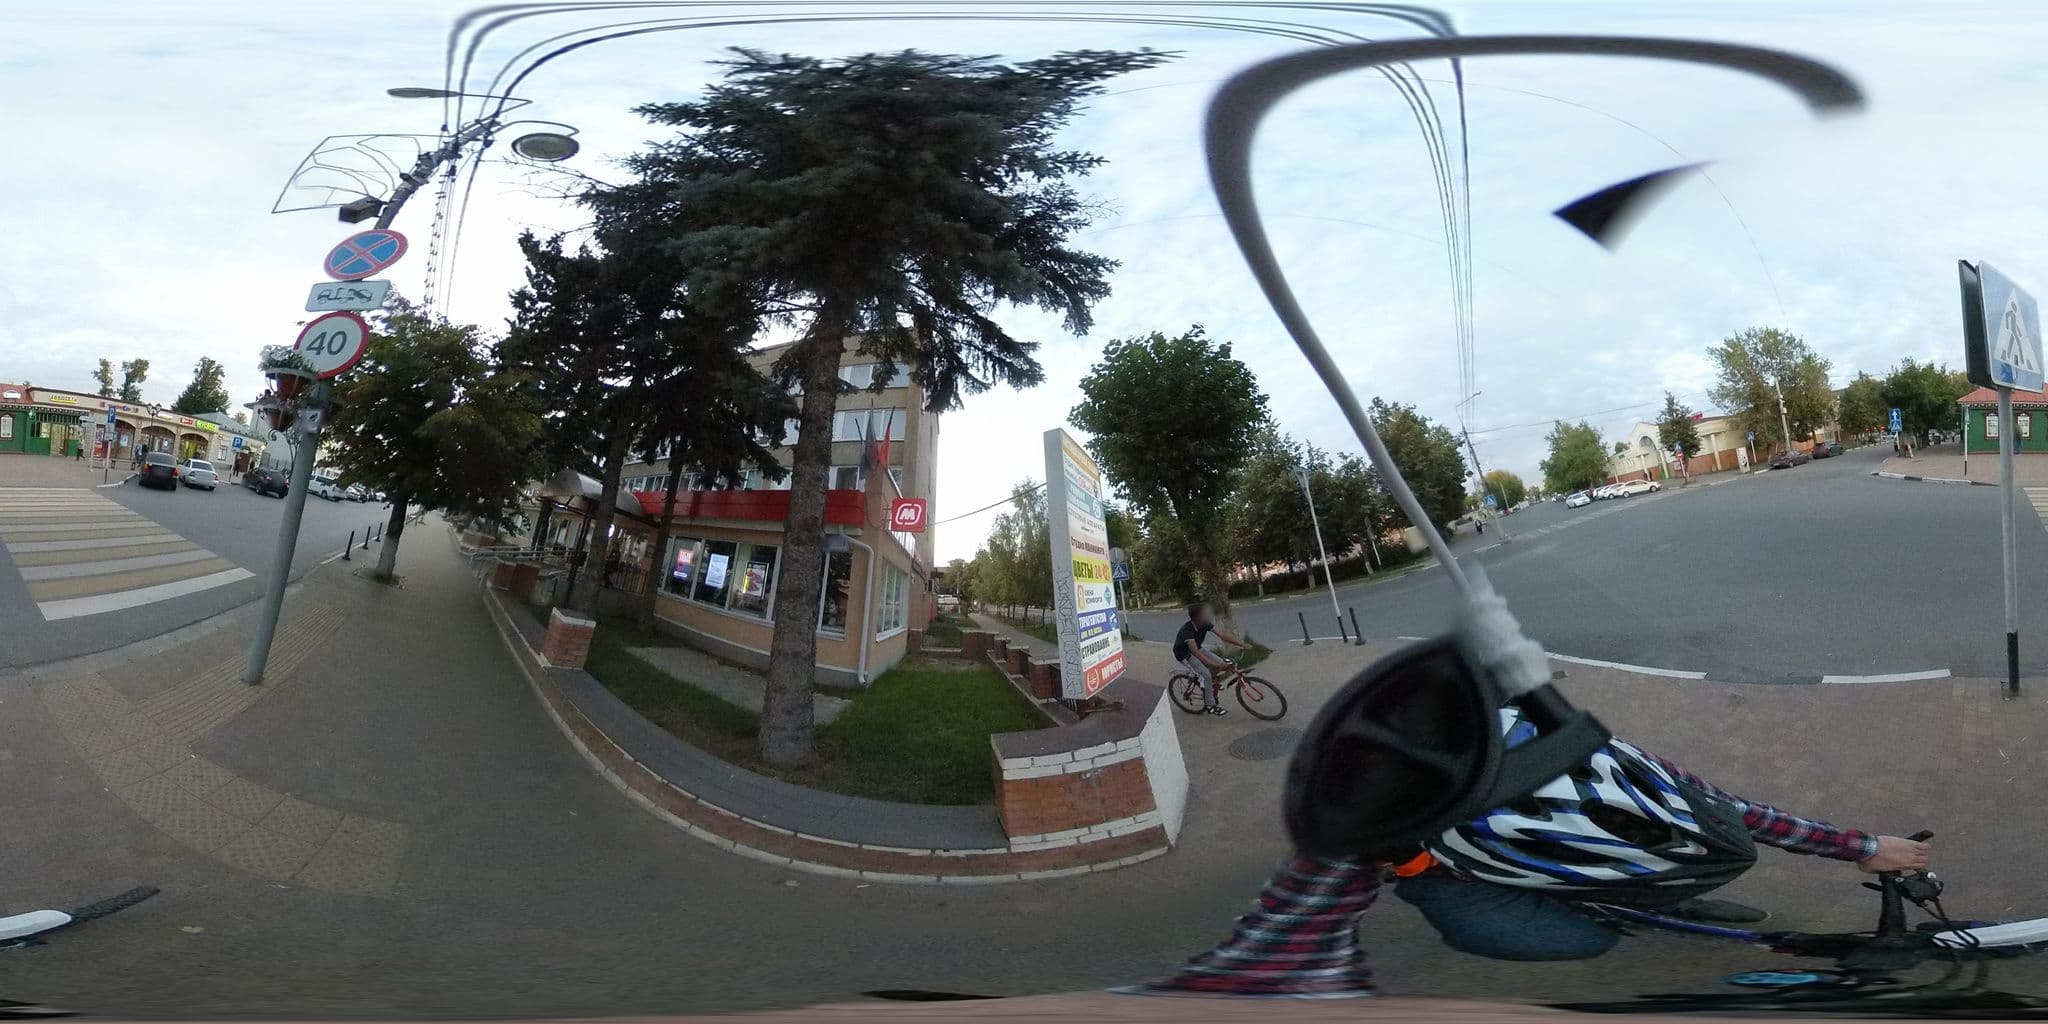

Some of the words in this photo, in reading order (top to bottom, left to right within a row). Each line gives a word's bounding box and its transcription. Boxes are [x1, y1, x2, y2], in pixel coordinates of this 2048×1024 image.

[306, 330, 347, 356] 40
[1073, 559, 1094, 580] ЦВЕТЫ
[1081, 637, 1110, 659] СТРАХОВАНИЕ
[1101, 657, 1123, 681] ЮРИСТЫ
